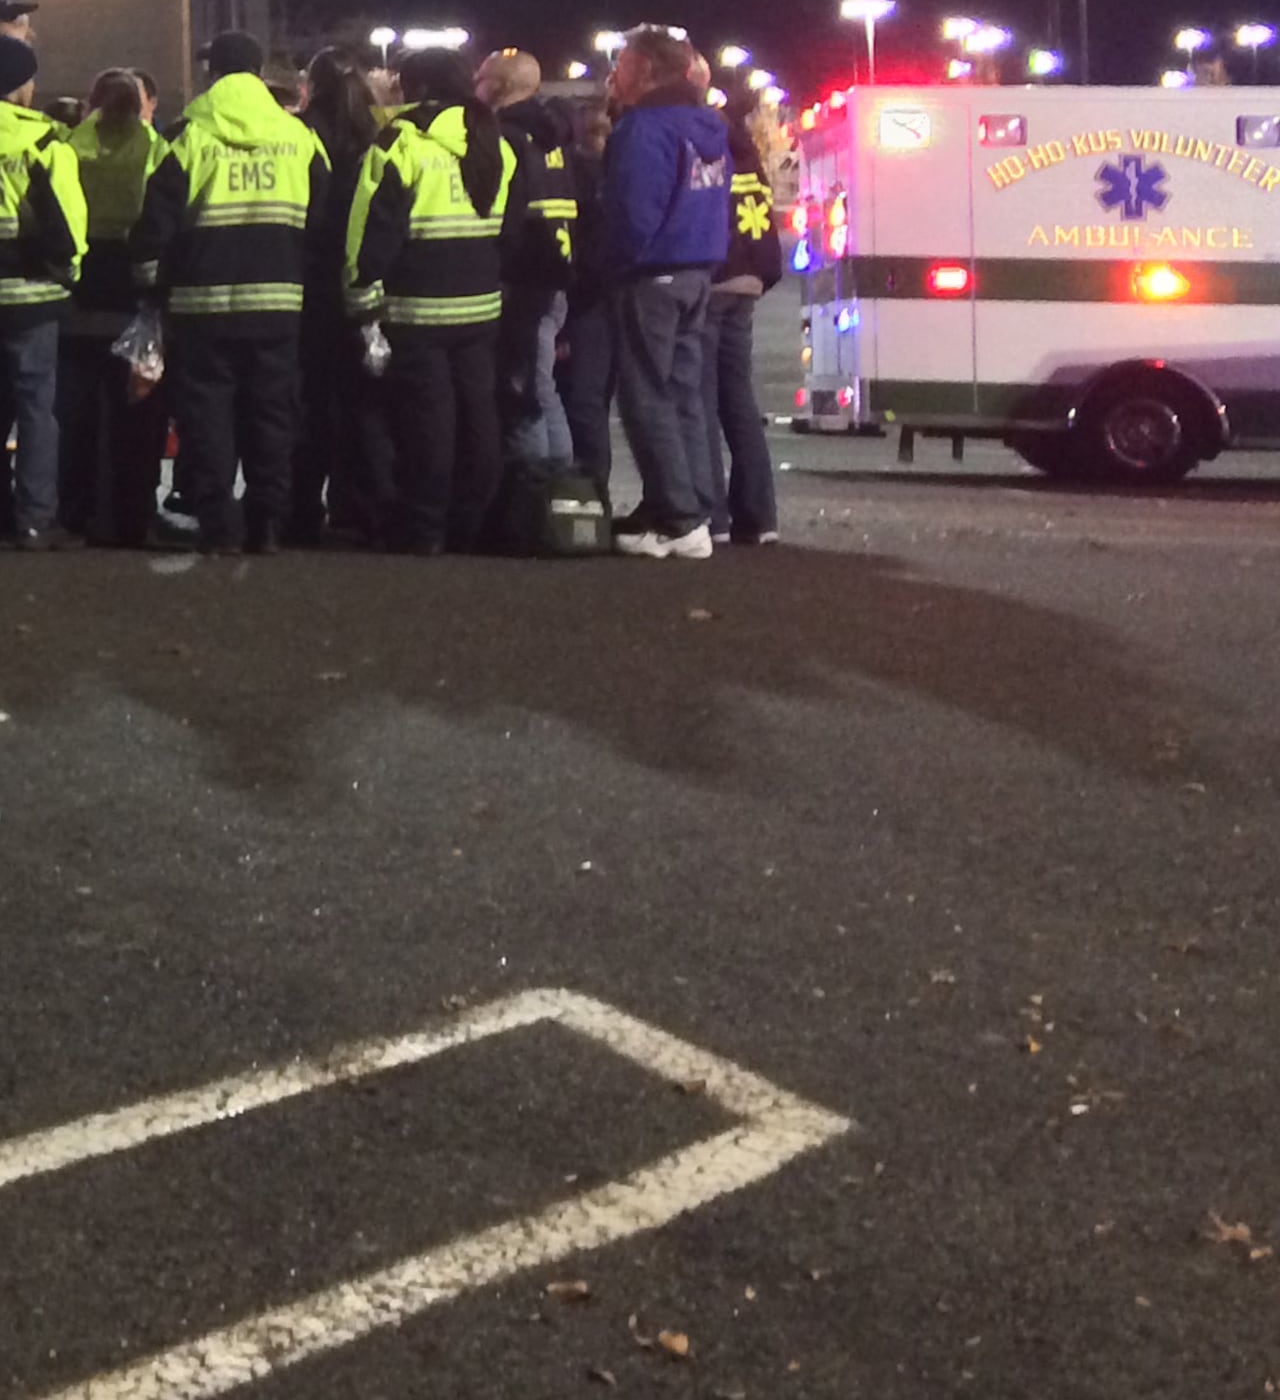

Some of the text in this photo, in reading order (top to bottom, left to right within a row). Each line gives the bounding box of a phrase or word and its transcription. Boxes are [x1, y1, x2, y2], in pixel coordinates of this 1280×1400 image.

[228, 160, 276, 192] EMS
[1131, 129, 1280, 193] VOLUNTEER
[1027, 224, 1254, 249] AMBULANCE
